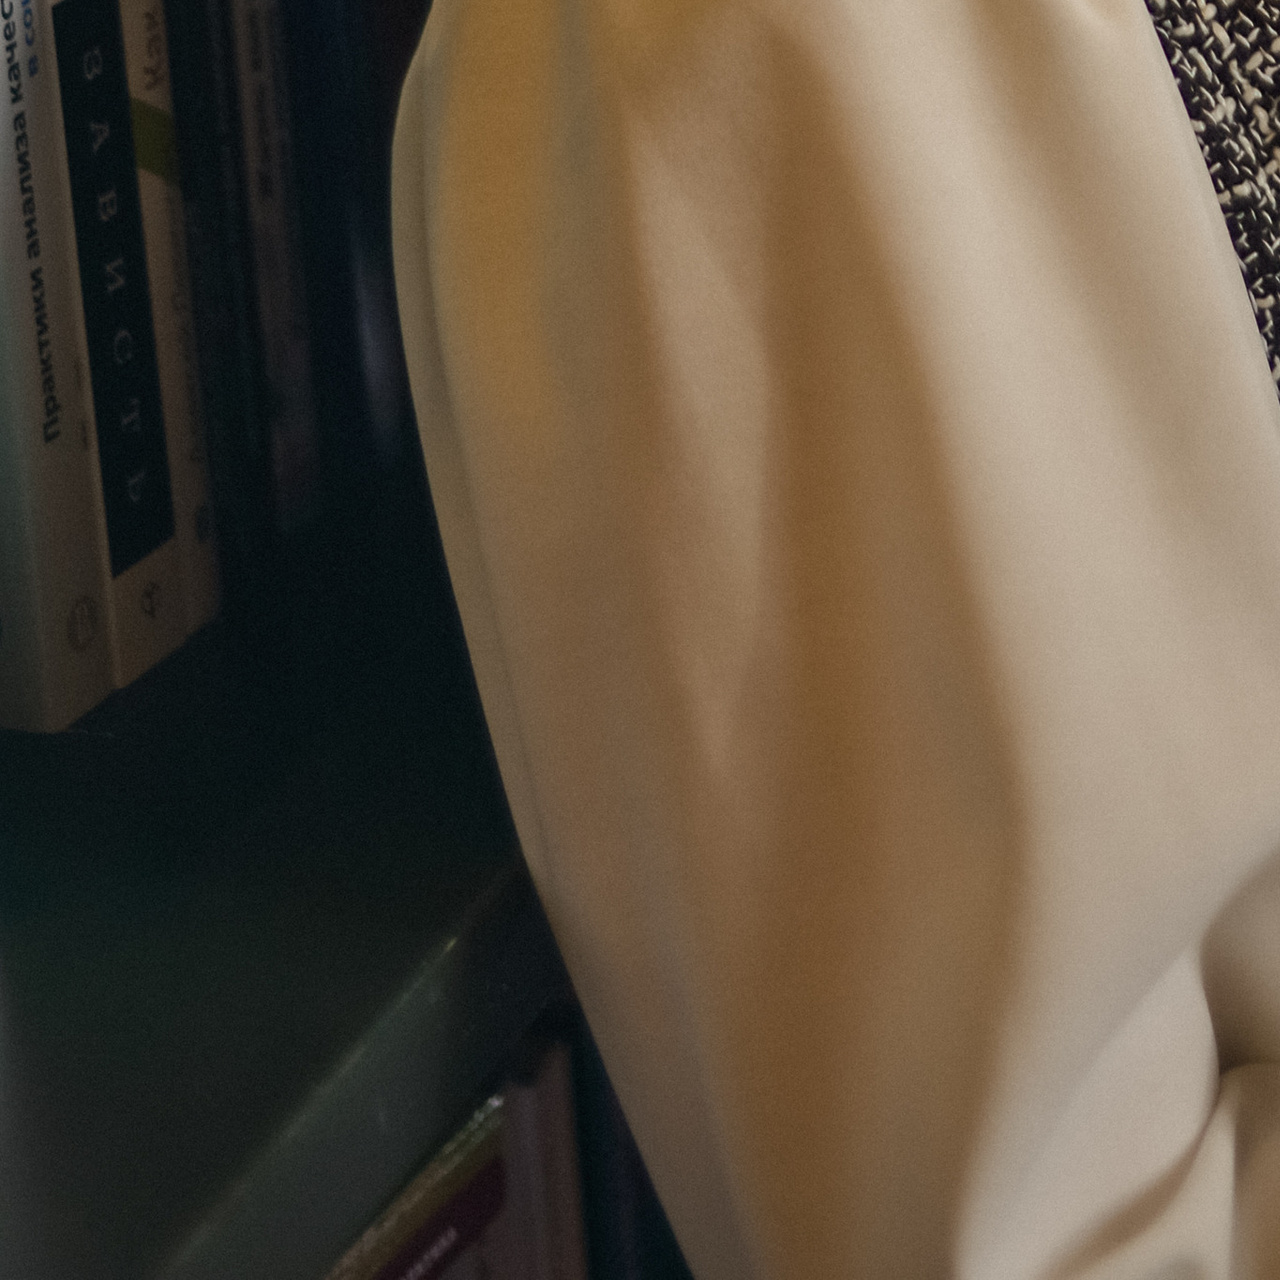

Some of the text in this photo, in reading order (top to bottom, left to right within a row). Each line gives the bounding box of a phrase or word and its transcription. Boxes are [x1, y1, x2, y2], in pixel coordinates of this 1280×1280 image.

[140, 7, 166, 91] Как
[12, 111, 41, 260] анализа
[82, 46, 147, 504] ЗАВИСТЬ
[30, 269, 62, 444] Практики
